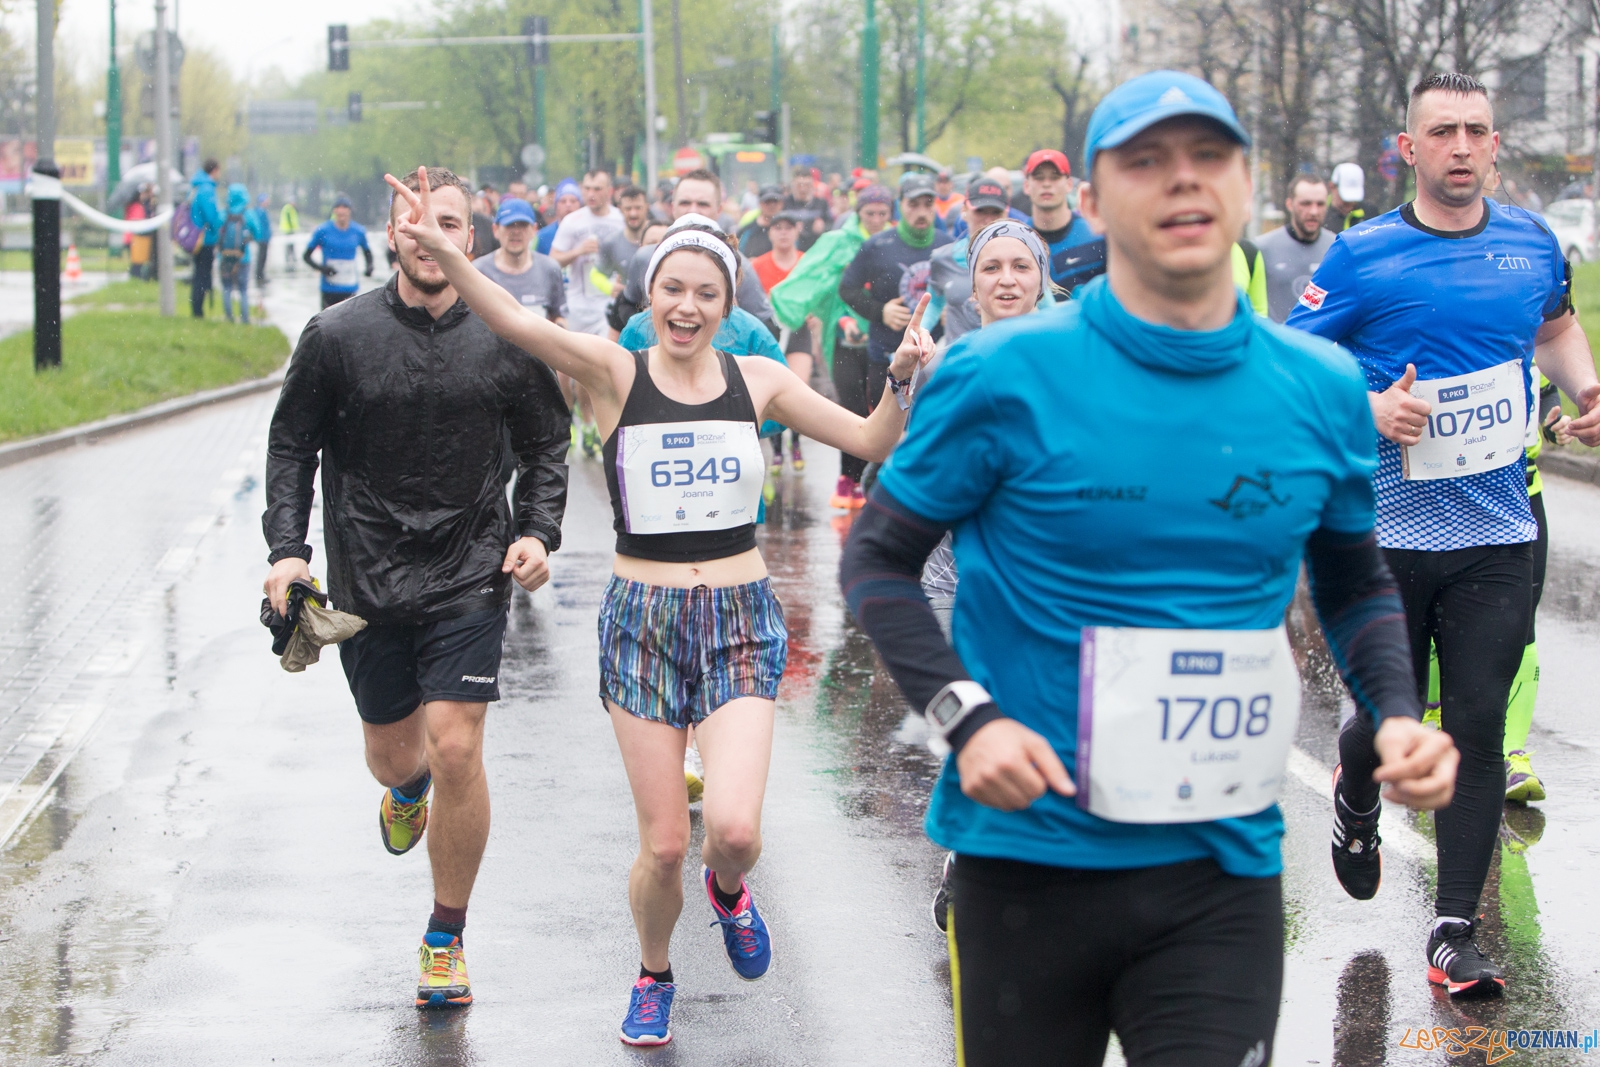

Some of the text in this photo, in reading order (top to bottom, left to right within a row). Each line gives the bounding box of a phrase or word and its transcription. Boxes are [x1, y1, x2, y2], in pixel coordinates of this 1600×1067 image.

[1495, 253, 1531, 270] ztm
[1427, 398, 1513, 439] 10790
[1463, 435, 1487, 446] Jakub
[650, 456, 741, 488] 6349
[681, 490, 714, 499] Joanna
[1156, 692, 1273, 742] 1708
